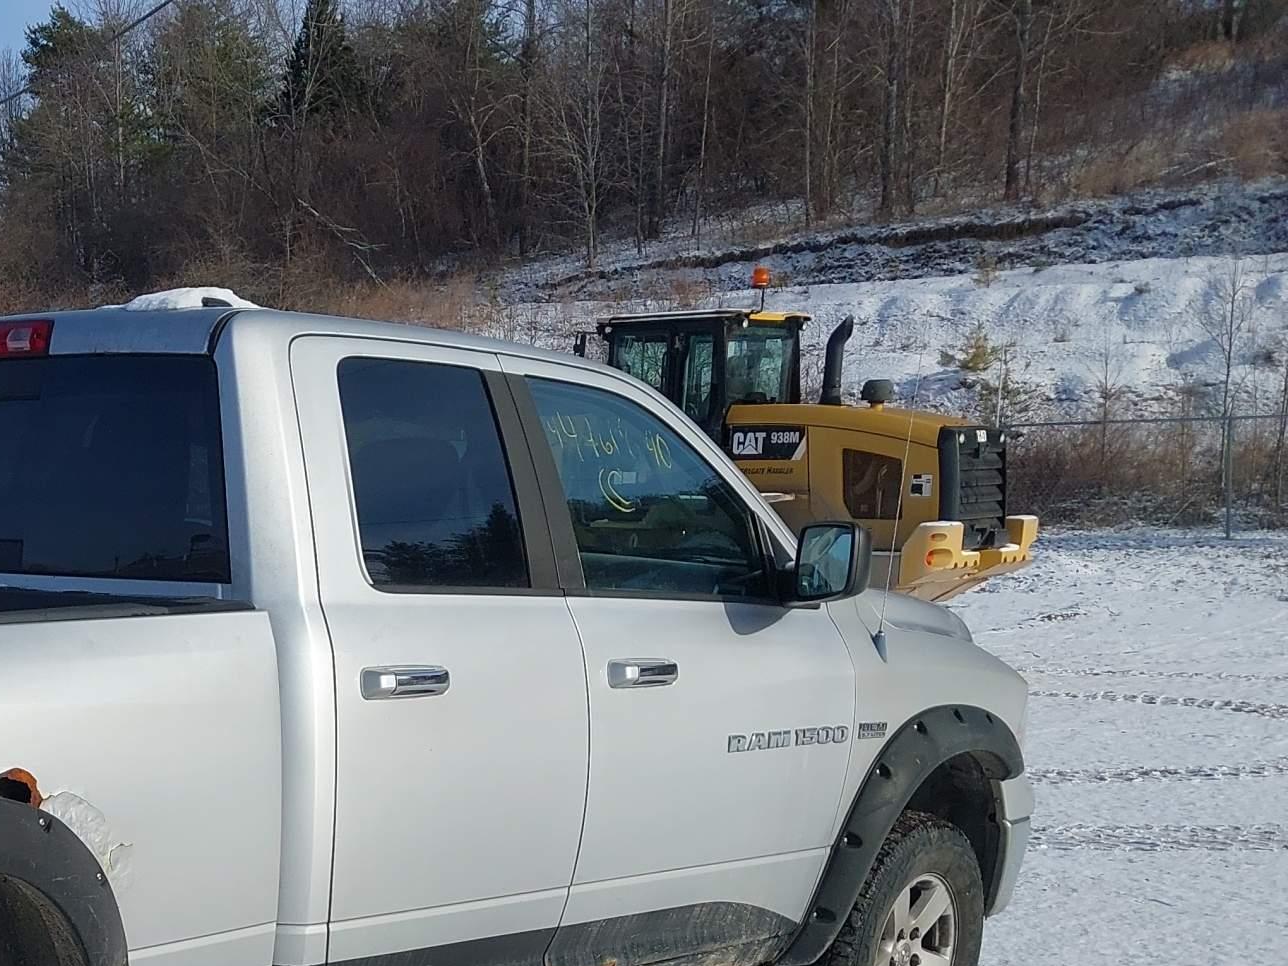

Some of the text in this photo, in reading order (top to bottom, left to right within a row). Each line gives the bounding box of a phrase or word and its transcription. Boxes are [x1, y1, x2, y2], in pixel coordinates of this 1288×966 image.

[732, 431, 800, 455] CAT 938M
[728, 725, 849, 753] RAM 1500
